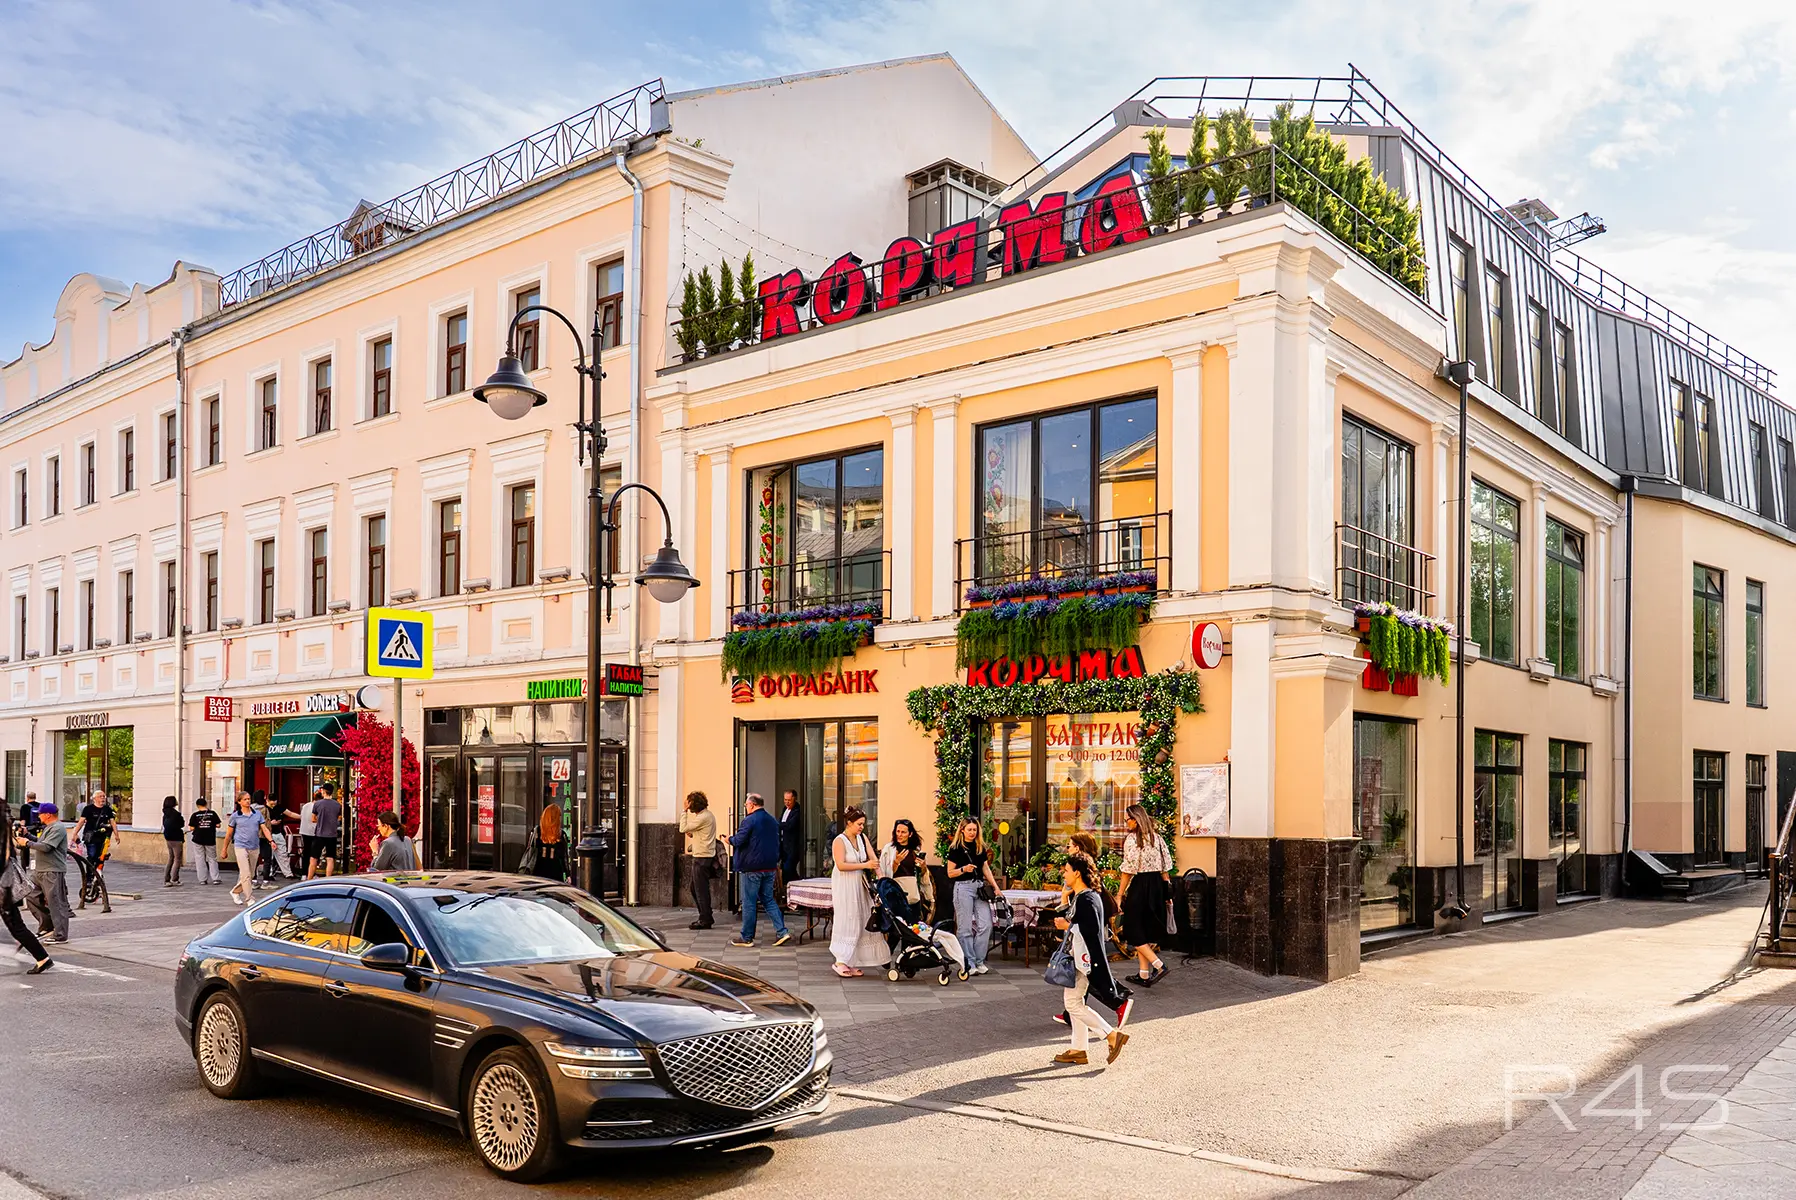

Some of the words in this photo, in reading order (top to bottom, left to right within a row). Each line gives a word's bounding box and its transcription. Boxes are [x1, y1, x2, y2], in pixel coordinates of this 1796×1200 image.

[610, 665, 642, 682] ТАБАК
[527, 678, 582, 699] НАПИТКИ
[610, 681, 642, 694] НАПИТКИ
[759, 669, 879, 698] ФОРАБАНК
[209, 698, 230, 706] BAO
[251, 702, 281, 715] BUBBLE
[283, 701, 299, 713] TEA
[306, 694, 339, 712] DONER
[209, 706, 230, 716] BEI
[1046, 722, 1139, 746] ЗАВТРАК
[268, 745, 288, 754] DONER
[1067, 750, 1089, 761] 9.00
[1091, 753, 1106, 762] до
[1110, 749, 1139, 761] 12.00
[553, 760, 568, 779] 24
